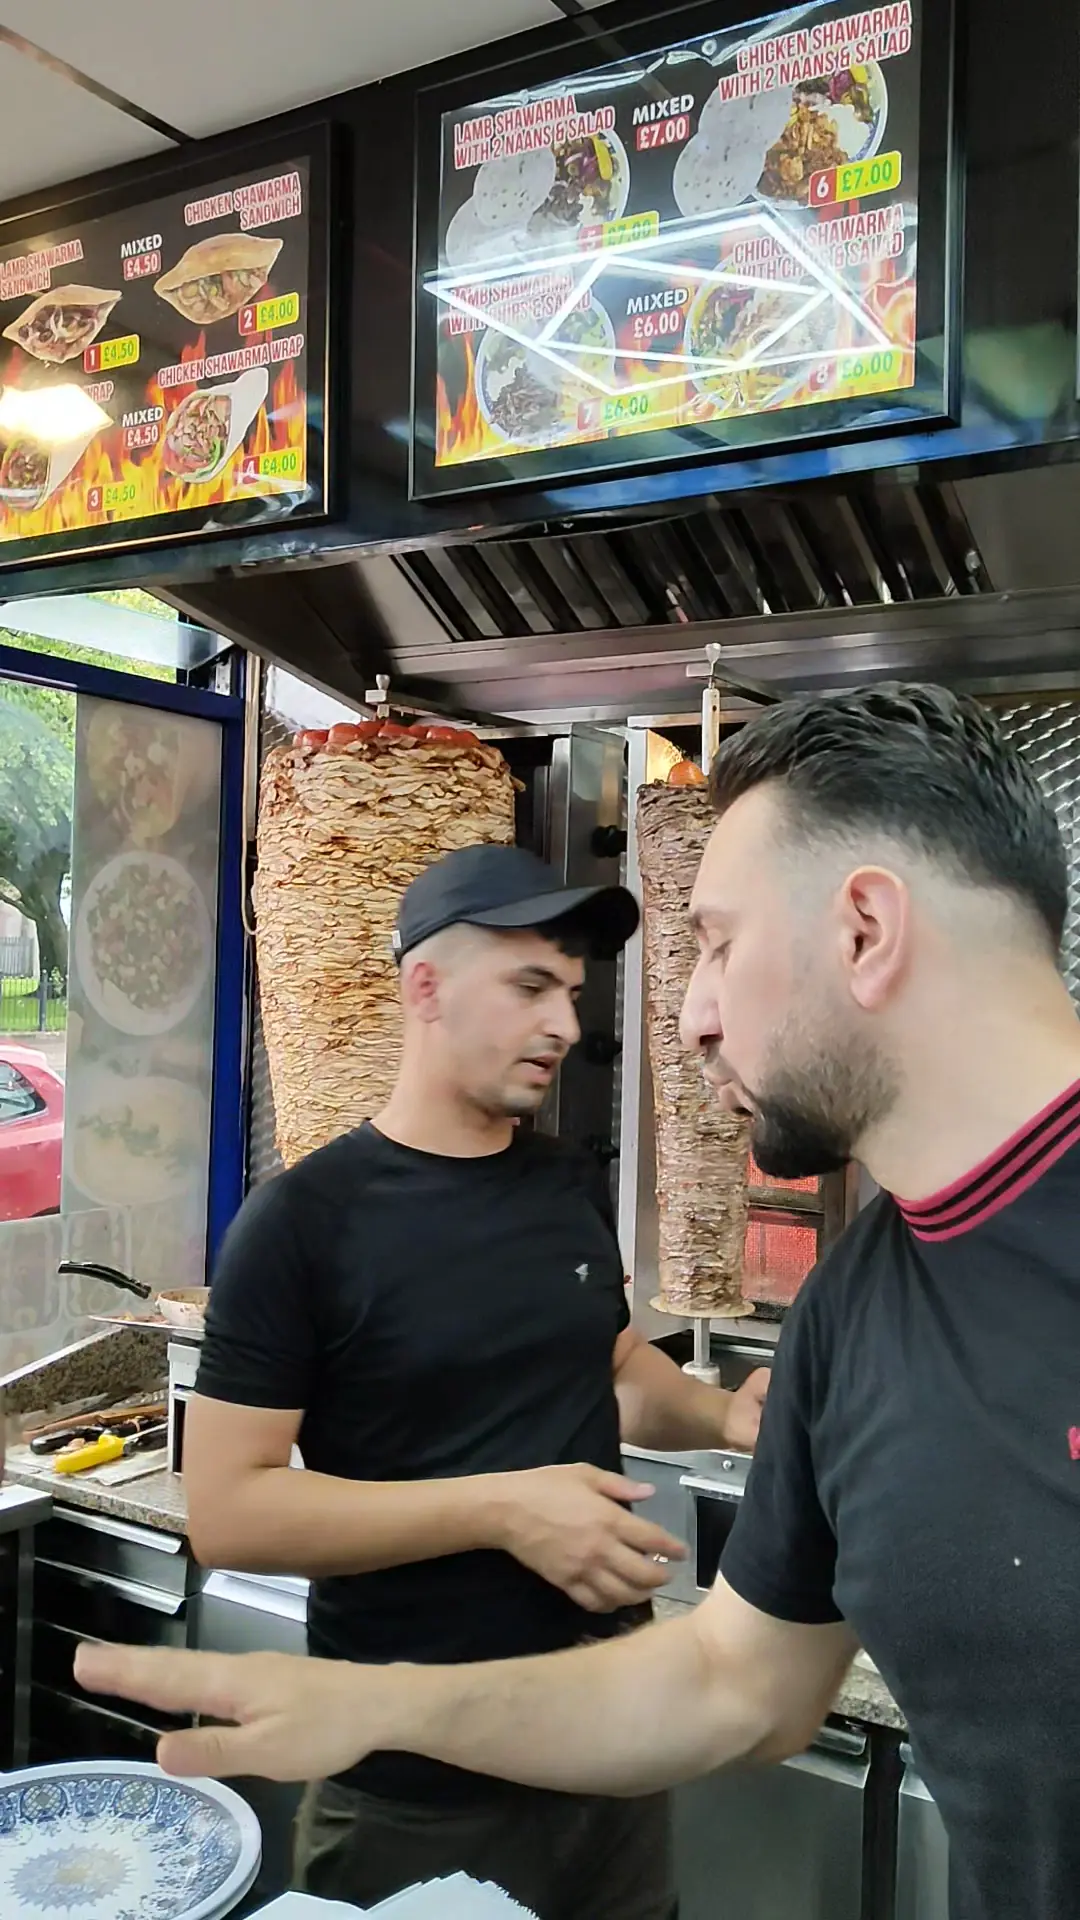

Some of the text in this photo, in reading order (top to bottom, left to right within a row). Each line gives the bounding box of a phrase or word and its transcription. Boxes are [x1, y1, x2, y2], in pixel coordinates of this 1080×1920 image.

[738, 2, 911, 71] CHICKEN SHAWARMA
[720, 28, 910, 100] WITH 2 NAANS & SALAD
[455, 95, 576, 145] LAMB SHAWARMA
[632, 94, 694, 125] MIXED
[455, 107, 614, 167] WITH 2 NAANS & SALAD
[639, 119, 686, 149] £7.00
[816, 160, 893, 198] 6 £7.00
[185, 173, 300, 225] CHICKEN SHAWARMA
[240, 196, 301, 230] SANDWICH
[607, 219, 652, 246] £7.00
[806, 205, 903, 244] SHAWARMA
[1, 240, 83, 280] LAMB SHAWARMA
[121, 234, 162, 258] MIXED
[126, 254, 158, 277] £4.50
[1, 271, 50, 298] SANDWICH
[244, 299, 294, 328] 2 £4.00
[627, 288, 688, 315] MIXED
[634, 314, 679, 339] £6.00
[90, 340, 134, 366] 1 £4.50
[158, 336, 303, 387] CHICKEN SHAWARMA WRAP
[842, 350, 893, 379] £6.00
[122, 406, 163, 427] MIXED
[583, 395, 649, 425] 7 £6.00
[127, 426, 158, 447] £4.50
[244, 453, 297, 476] 4 £4.00
[90, 485, 136, 507] 3 £4.50
